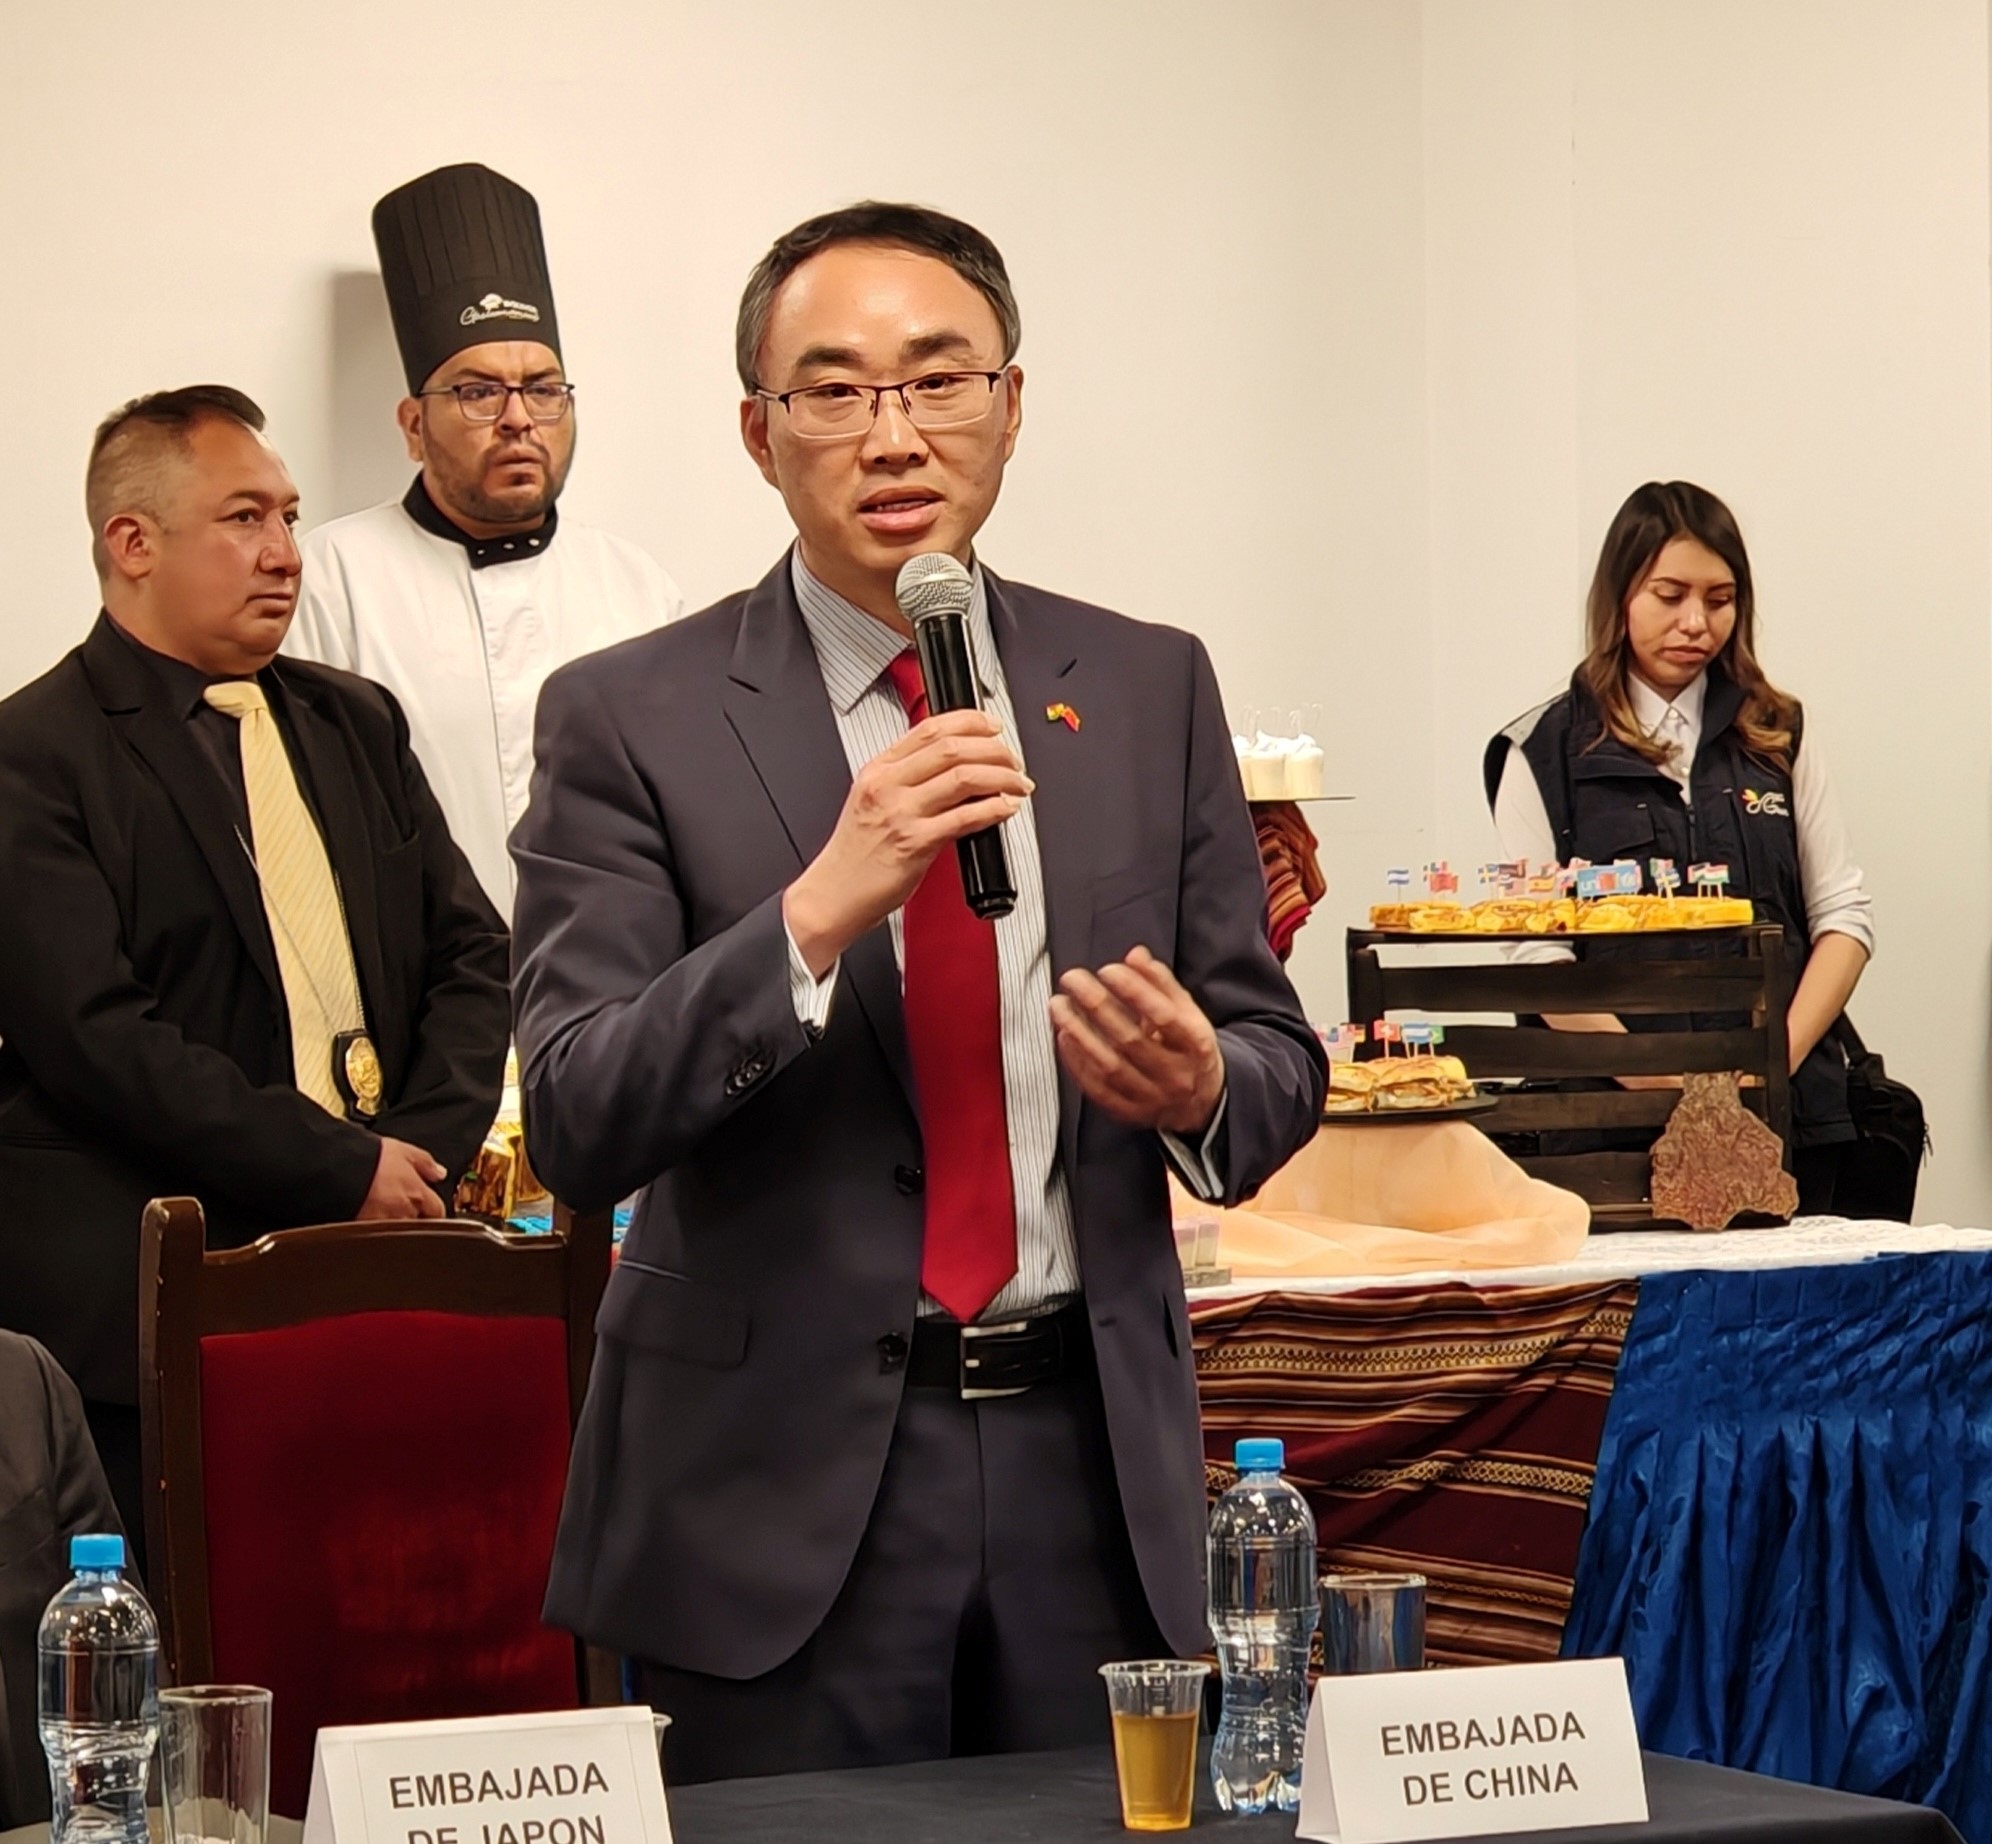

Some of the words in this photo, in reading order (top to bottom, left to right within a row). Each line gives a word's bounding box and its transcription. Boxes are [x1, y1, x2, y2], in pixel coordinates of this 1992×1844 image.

[1381, 1711, 1586, 1756] EMBAJADA
[389, 1761, 609, 1809] EMBAJADA
[1403, 1772, 1454, 1806] DE
[1464, 1761, 1579, 1800] CHINA
[482, 1815, 605, 1844] JAPON
